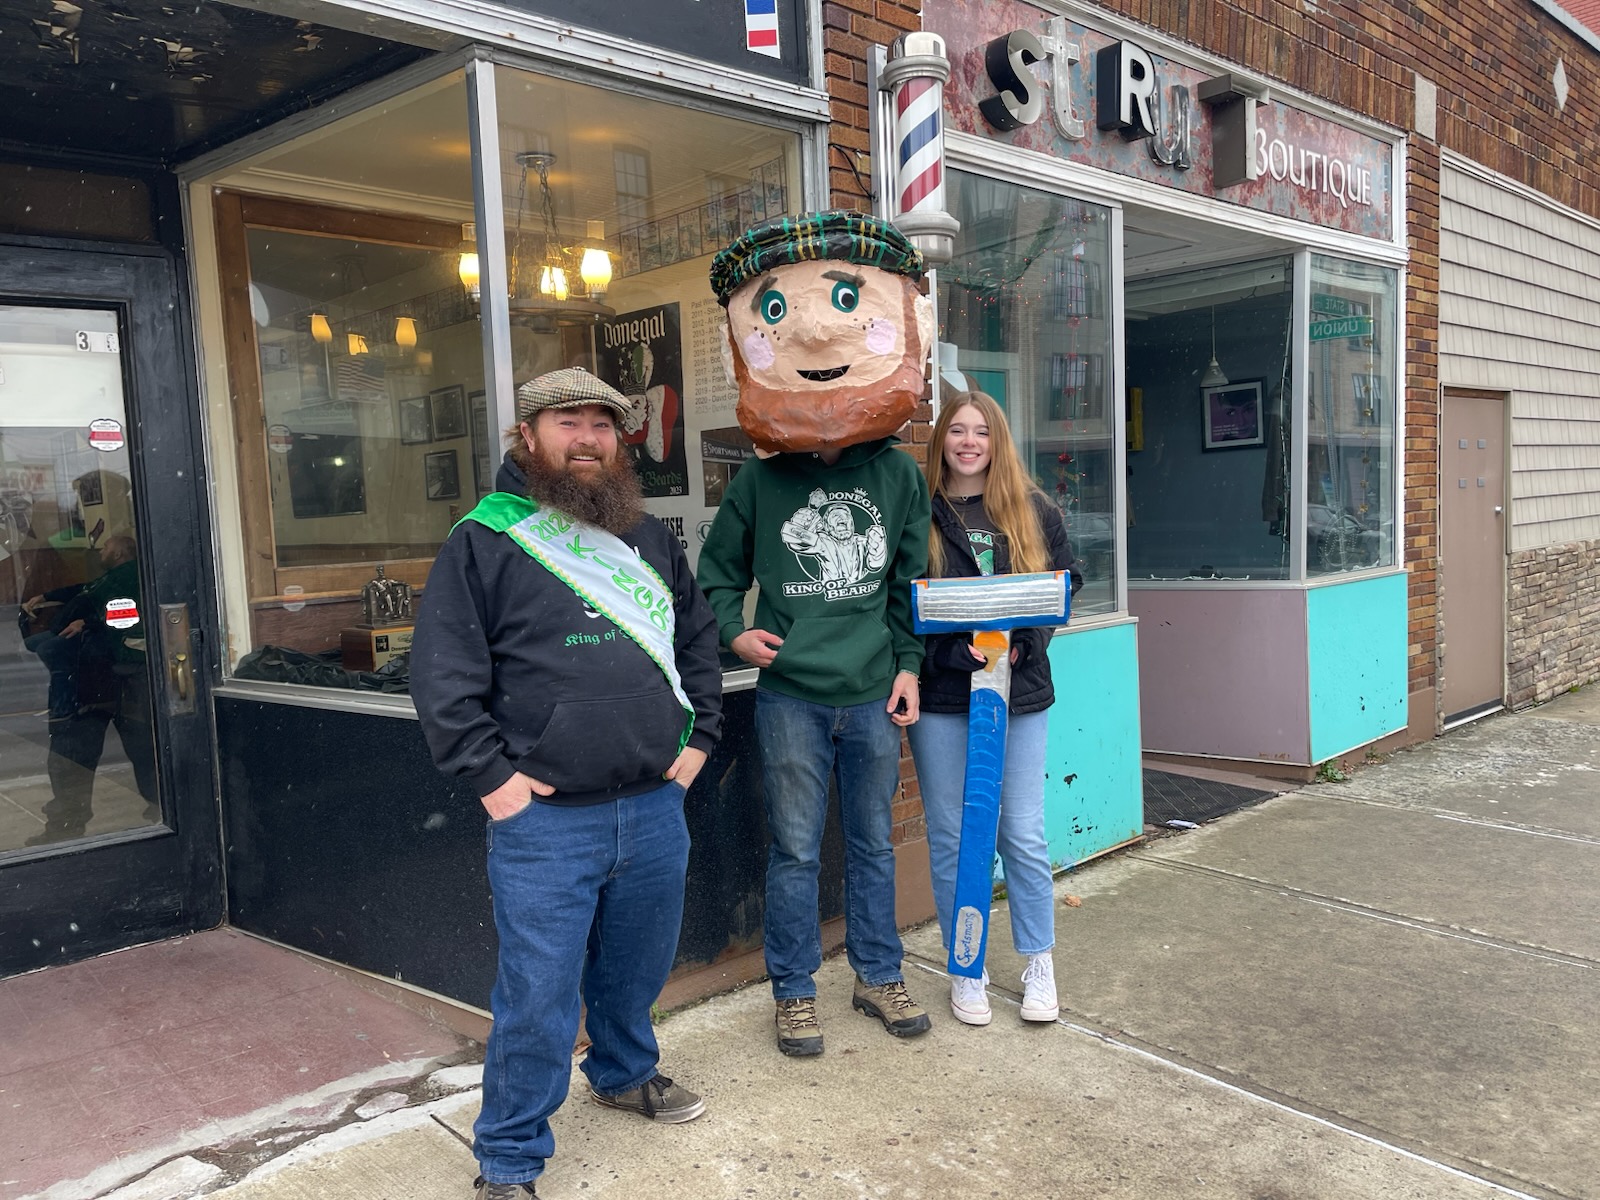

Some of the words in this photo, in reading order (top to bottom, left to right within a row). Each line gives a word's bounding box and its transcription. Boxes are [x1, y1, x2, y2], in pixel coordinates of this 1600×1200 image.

[1255, 128, 1371, 208] BOUTIQUE
[603, 309, 665, 349] Donegal
[828, 490, 883, 525] DONEGAL
[566, 533, 654, 610] KING
[783, 583, 824, 595] KING
[825, 579, 846, 589] OF
[826, 581, 881, 600] BEARDS
[564, 632, 601, 647] King
[604, 629, 617, 642] of
[956, 912, 976, 965] Sportsmans
